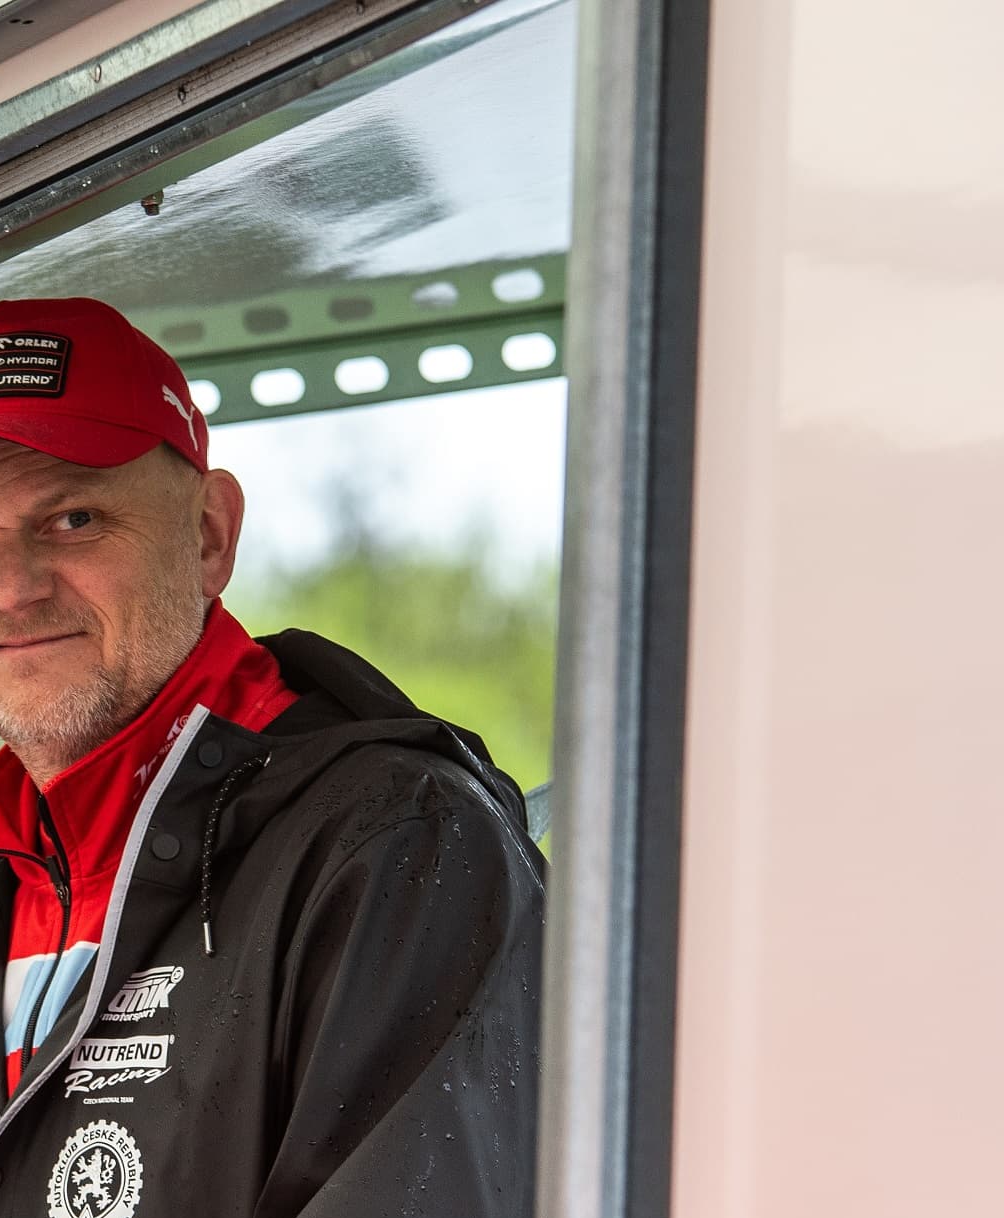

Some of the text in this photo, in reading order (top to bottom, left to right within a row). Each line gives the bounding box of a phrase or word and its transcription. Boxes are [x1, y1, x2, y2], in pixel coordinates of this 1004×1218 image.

[14, 338, 59, 349] ORLEN
[7, 357, 58, 366] HYUNDAI
[77, 1043, 163, 1063] NUTREND
[65, 1065, 172, 1098] Racing
[54, 1129, 137, 1208] AUTOKLUB ČESKÉ REPUBLIKY
